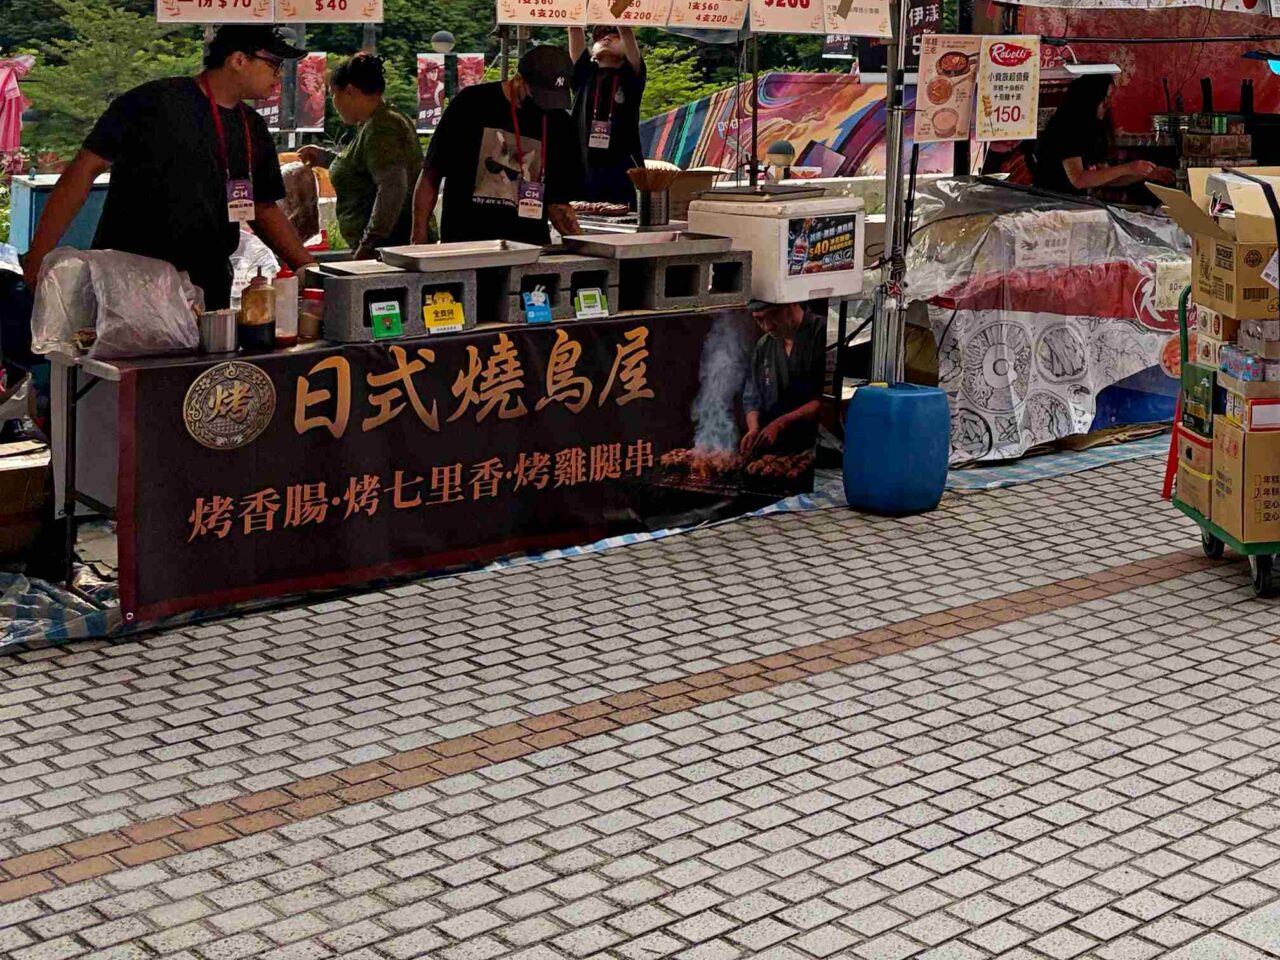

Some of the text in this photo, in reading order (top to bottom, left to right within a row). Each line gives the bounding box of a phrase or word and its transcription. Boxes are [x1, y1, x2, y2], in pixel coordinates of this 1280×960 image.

[688, 1, 720, 11] 1支$60
[529, 8, 567, 19] 4支200
[622, 9, 652, 20] 支200
[695, 13, 728, 23] 4支200
[231, 190, 249, 198] CH
[525, 190, 540, 198] CH
[294, 326, 656, 441] 日式燒鳥屋
[209, 388, 249, 424] 烤
[187, 440, 655, 543] 烤香腸·烤七里香·烤雞腿串
